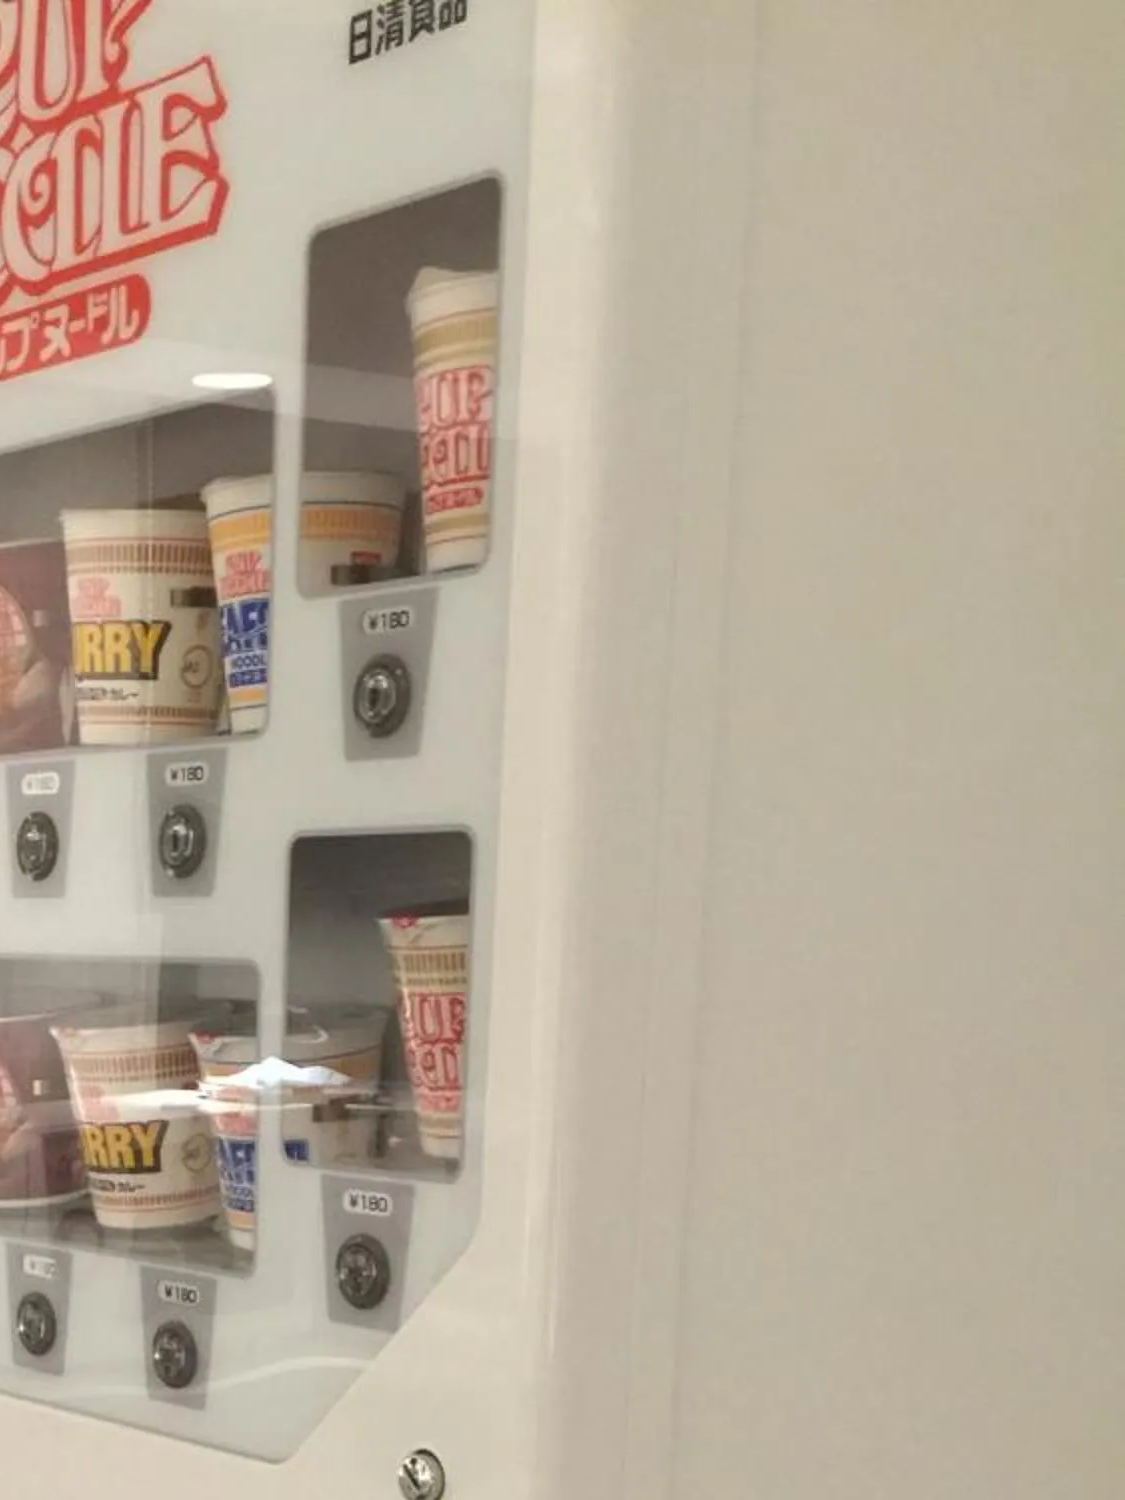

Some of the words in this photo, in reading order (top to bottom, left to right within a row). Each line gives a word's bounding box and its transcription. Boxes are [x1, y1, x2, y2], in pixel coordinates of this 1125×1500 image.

[349, 0, 467, 64] 日清食品
[74, 620, 172, 680] RRY
[82, 1119, 169, 1173] RRY
